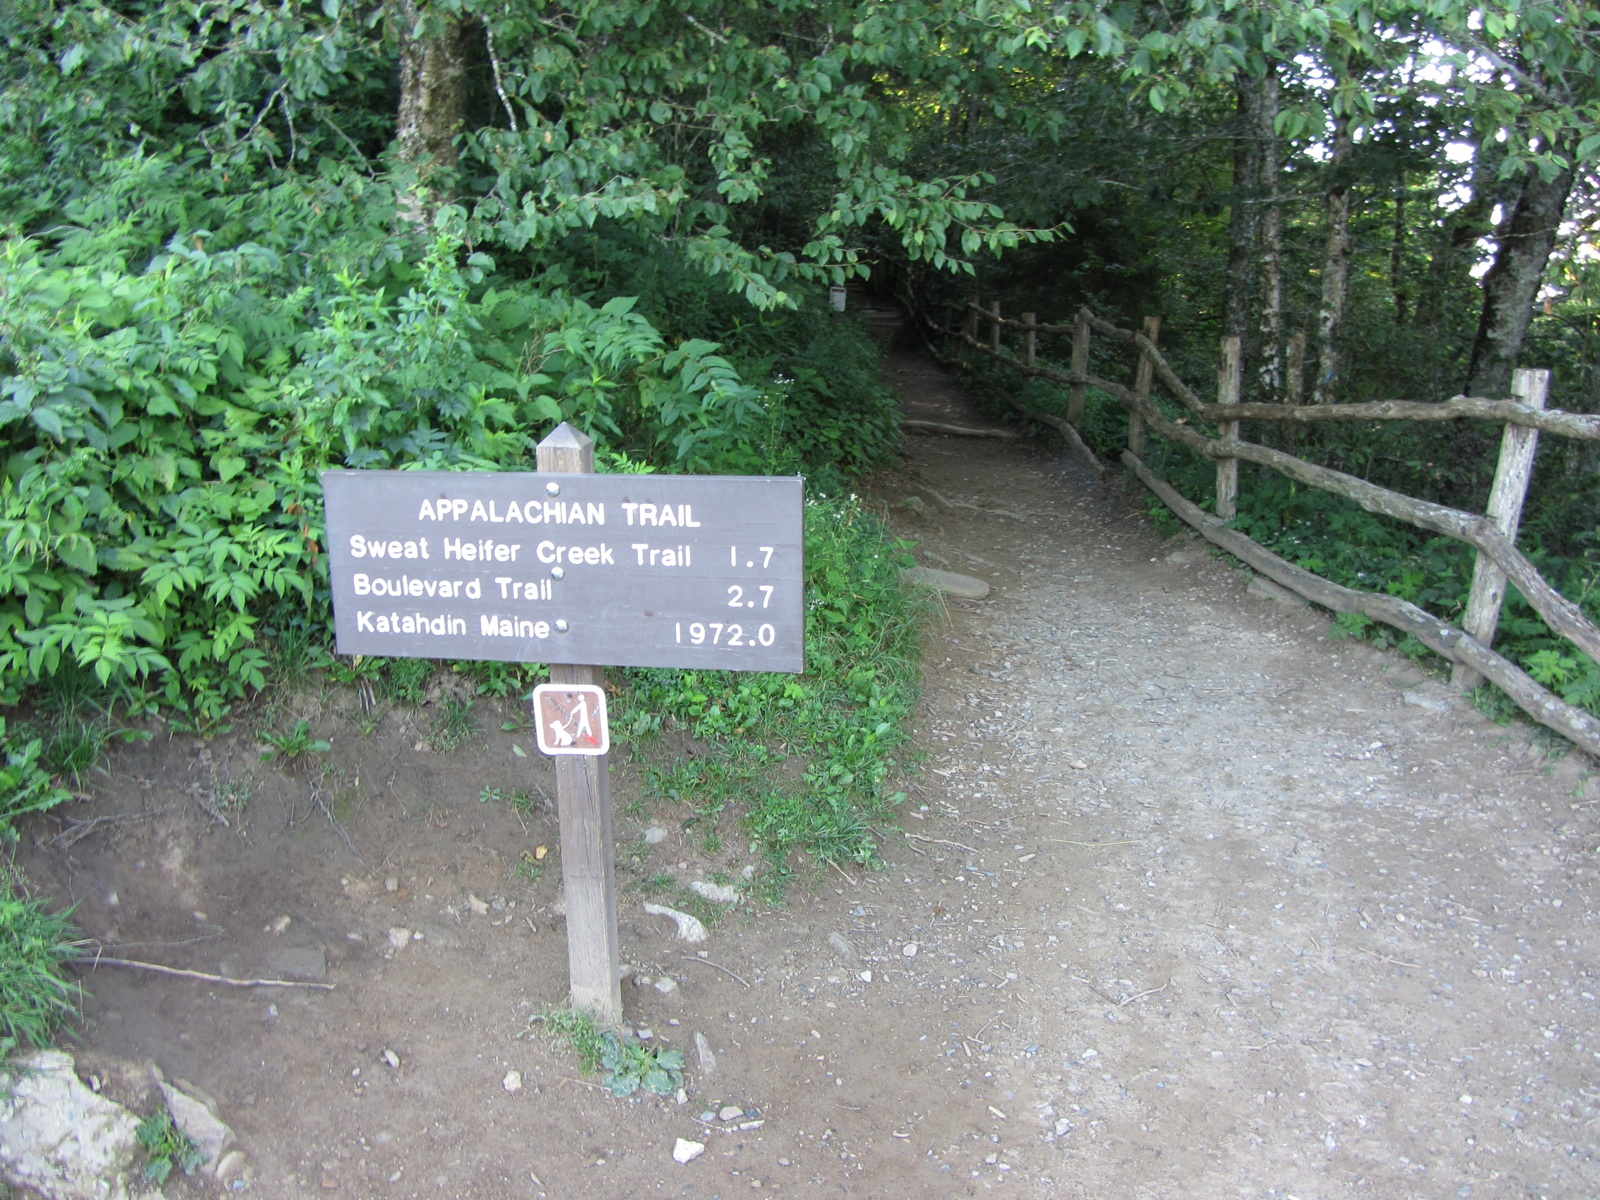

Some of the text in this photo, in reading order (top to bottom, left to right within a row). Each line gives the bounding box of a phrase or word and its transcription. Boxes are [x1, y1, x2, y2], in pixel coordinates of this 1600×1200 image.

[419, 499, 702, 527] APPALACHIAN TRAIL
[350, 535, 774, 568] Sweat Heifer Creek Trail 1.7
[354, 574, 774, 608] Boulevard Trail 2.7
[357, 611, 776, 646] Katahdin Maine 1972.0
